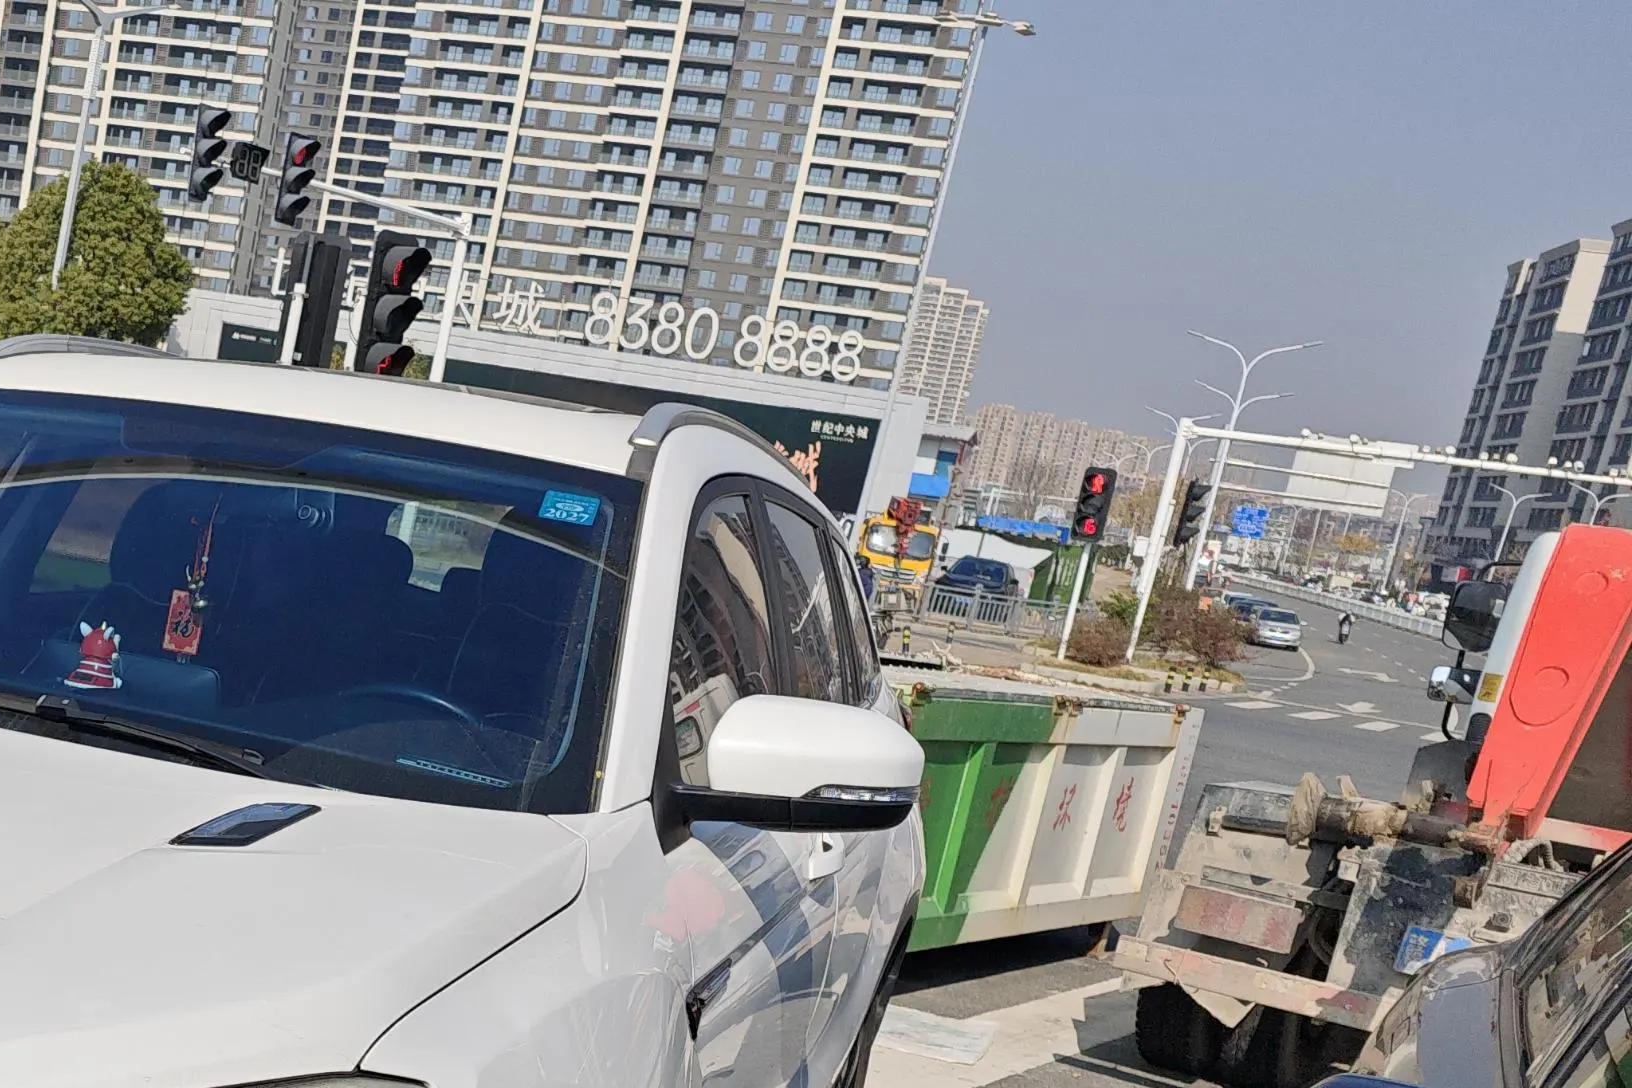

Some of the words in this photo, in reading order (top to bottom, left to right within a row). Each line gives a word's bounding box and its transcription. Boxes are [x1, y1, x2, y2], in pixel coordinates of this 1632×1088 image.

[584, 291, 719, 360] 8380
[734, 315, 864, 382] 8888
[810, 419, 869, 440] 世纪中央城
[543, 508, 590, 523] 2027
